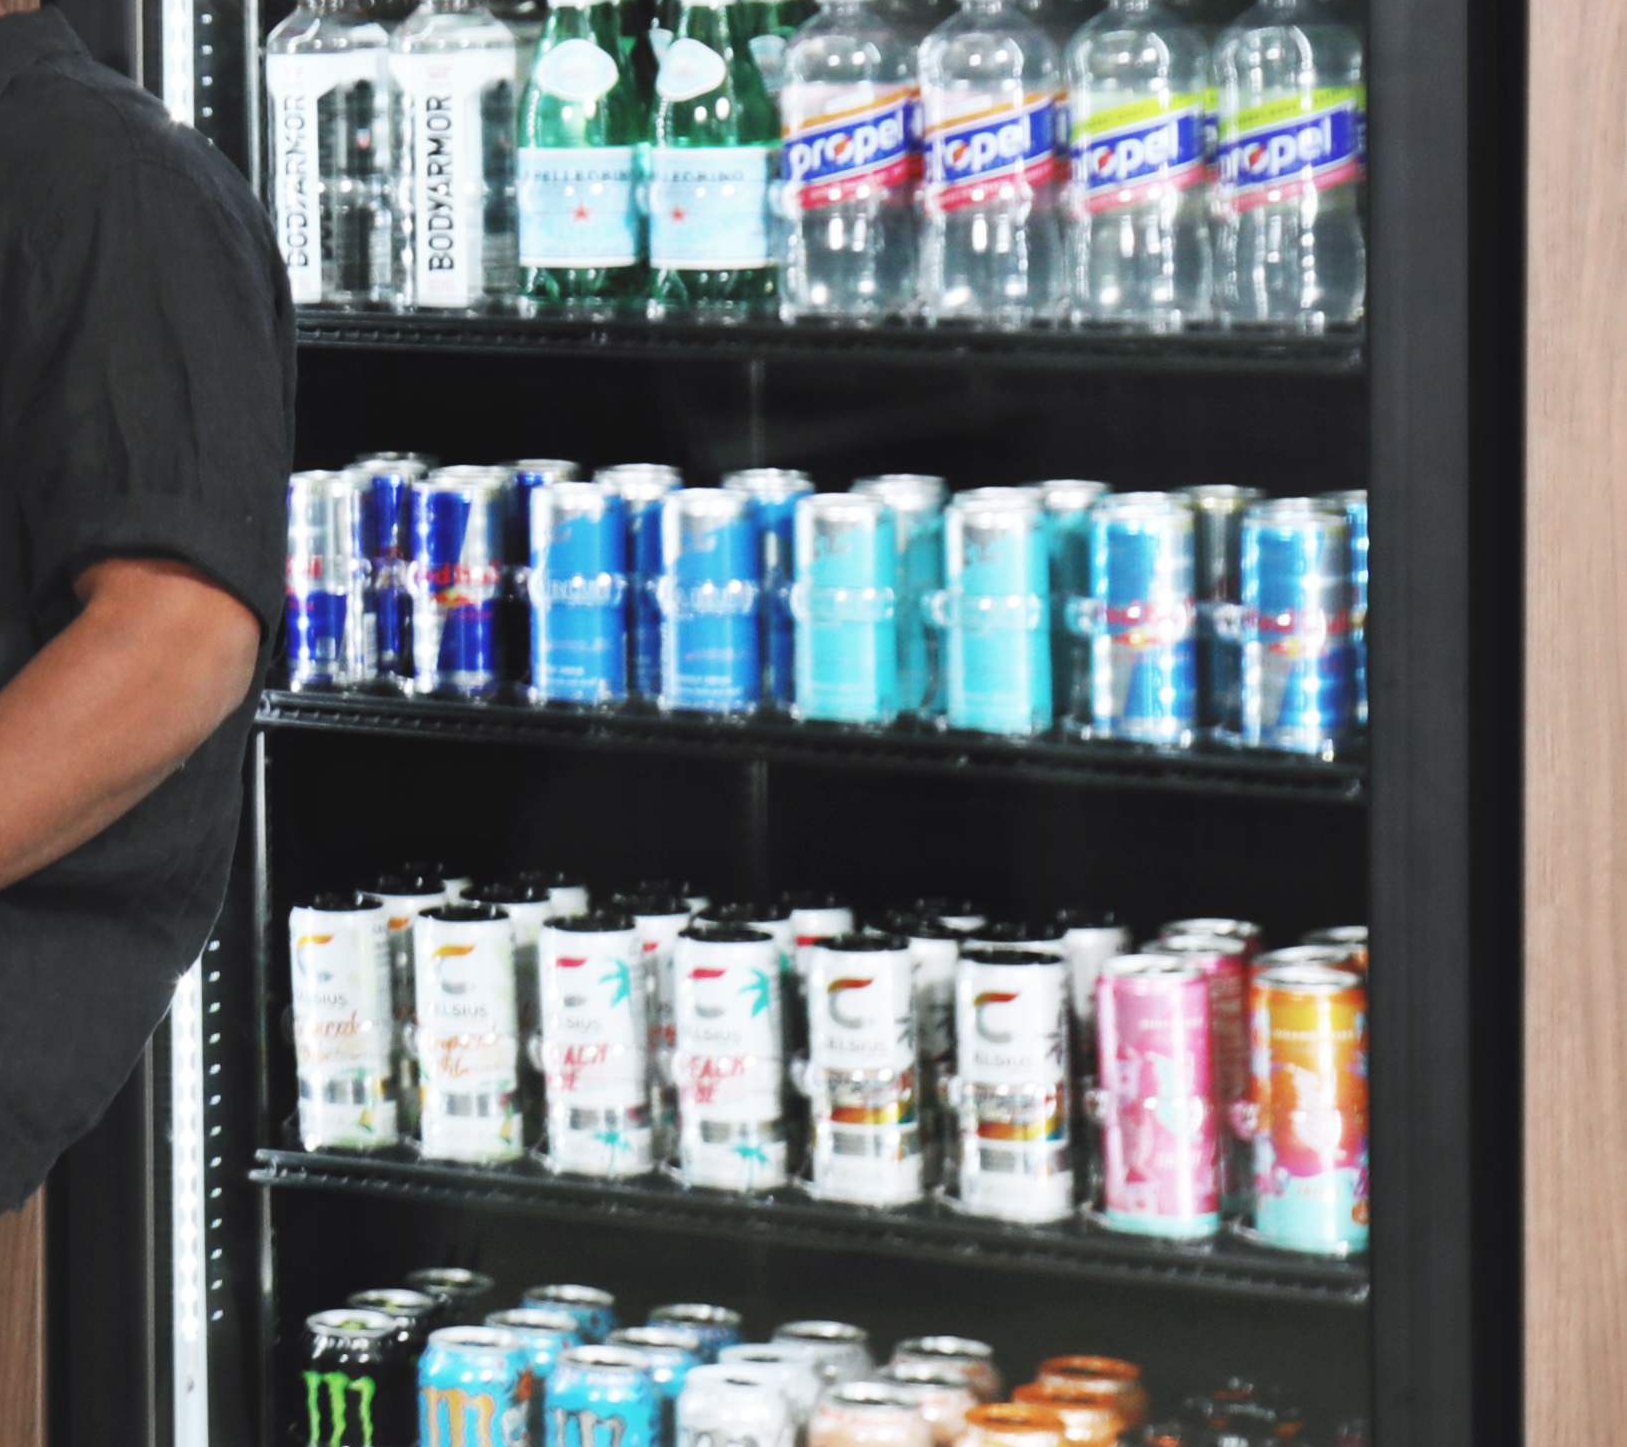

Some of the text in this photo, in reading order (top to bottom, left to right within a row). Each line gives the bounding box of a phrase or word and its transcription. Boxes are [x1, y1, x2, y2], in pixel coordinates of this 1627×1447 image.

[281, 94, 308, 269] BODYARMOR
[426, 95, 453, 273] BODYARMOR
[789, 106, 905, 177] propel
